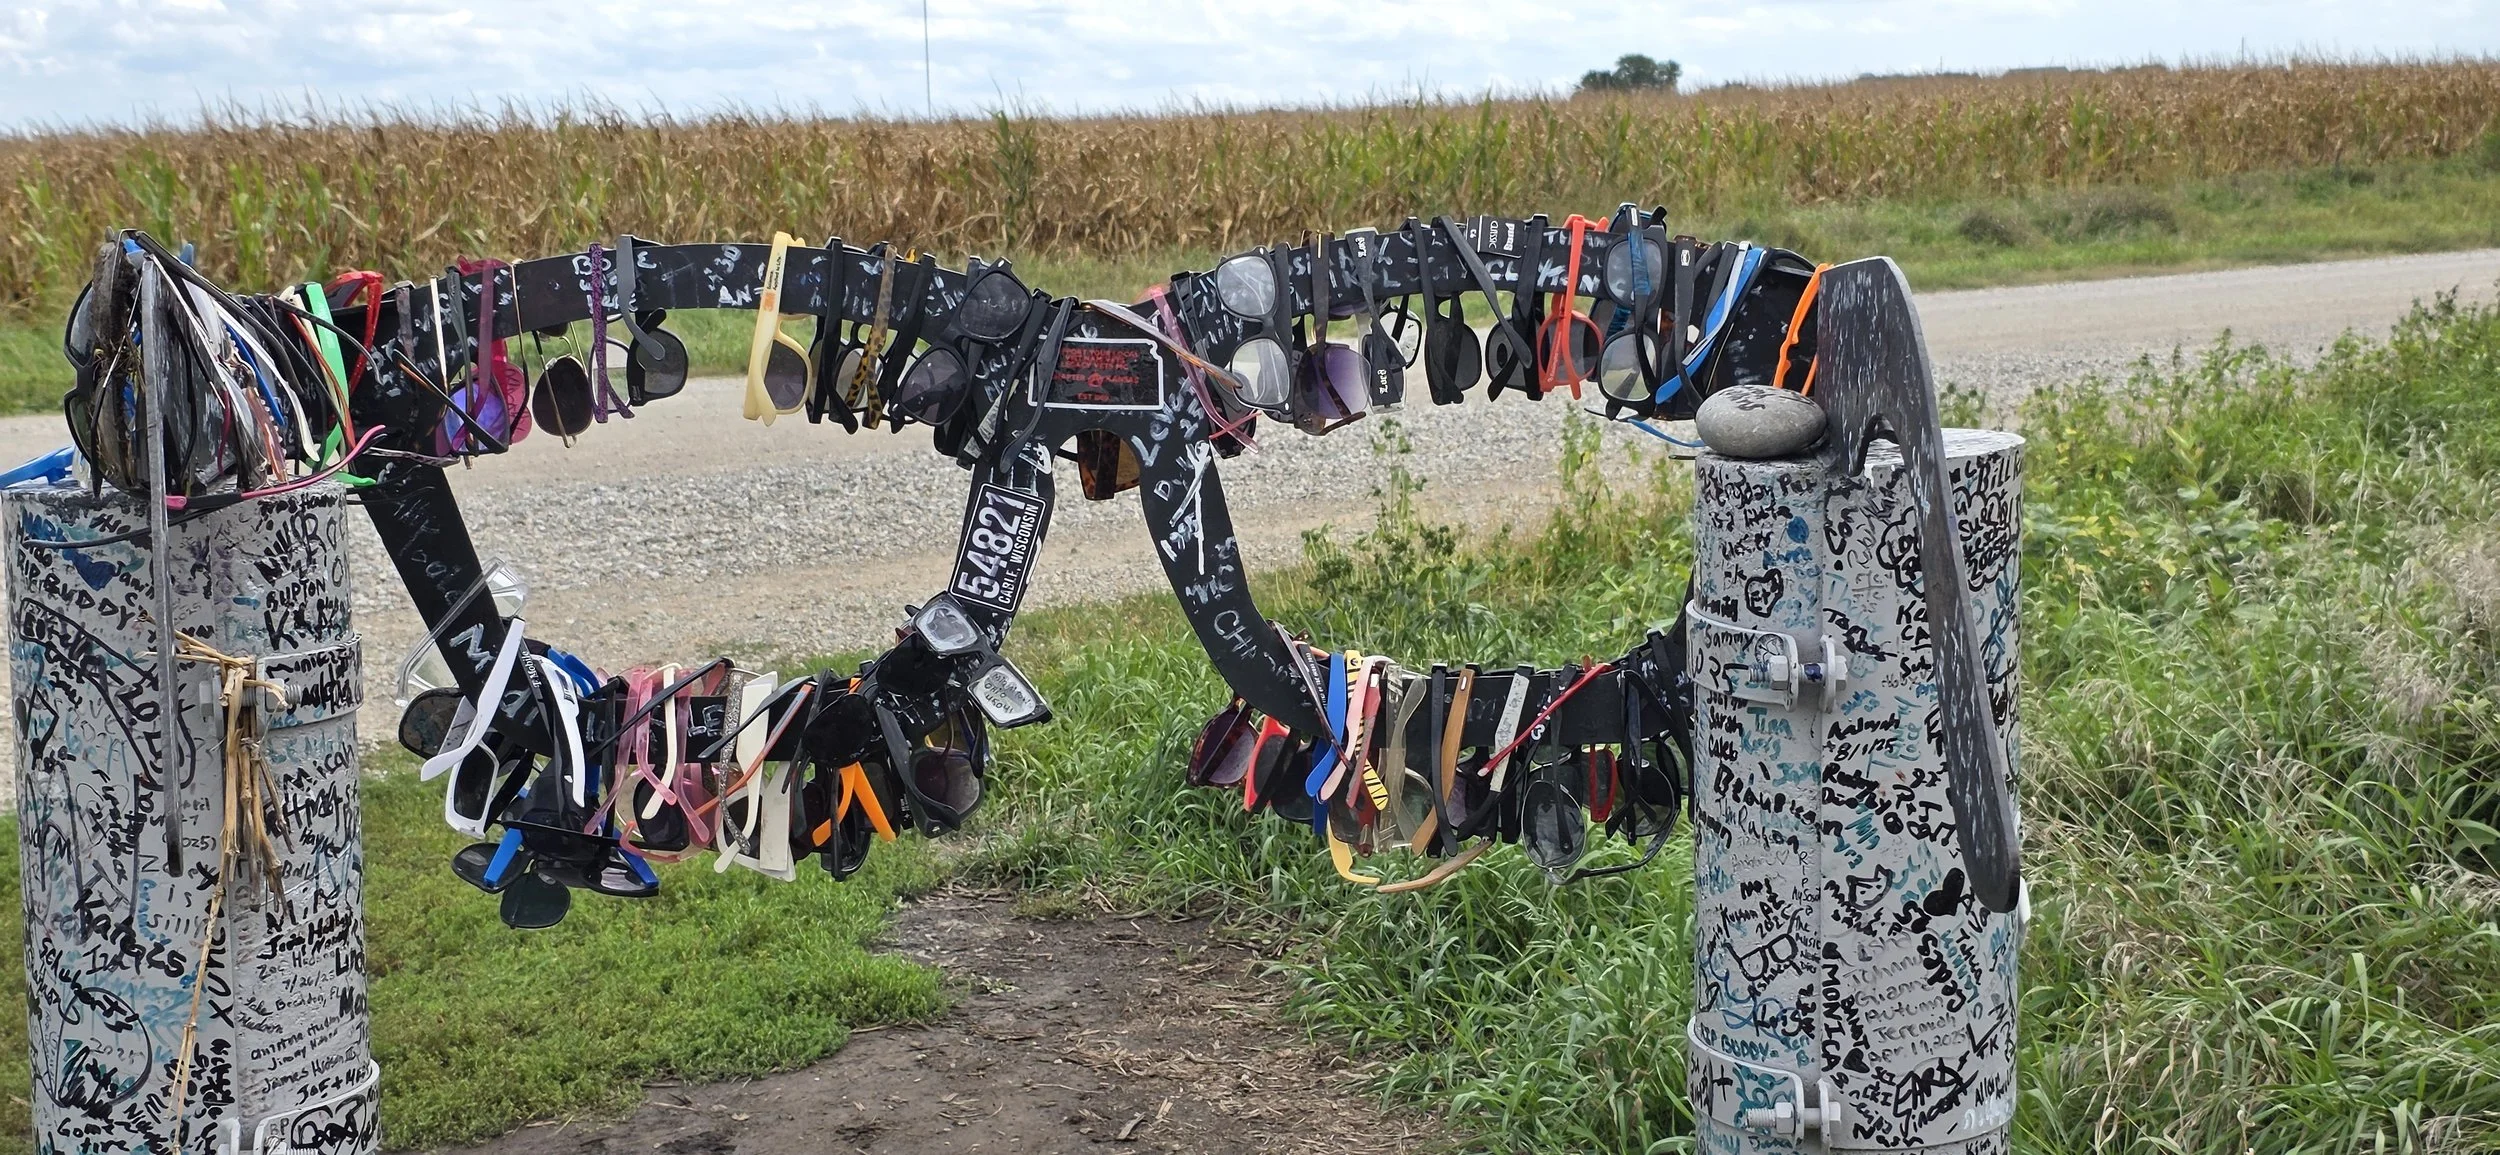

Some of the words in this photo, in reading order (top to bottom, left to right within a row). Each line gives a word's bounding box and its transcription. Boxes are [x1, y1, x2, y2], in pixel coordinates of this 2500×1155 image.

[957, 491, 1026, 600] 54821
[1009, 503, 1039, 564] WISCONSIN
[43, 572, 136, 630] BUDDY
[998, 569, 1022, 604] CABLE,
[1705, 624, 1758, 652] Sammy
[1821, 963, 1846, 1073] MONICA
[261, 1067, 309, 1094] James
